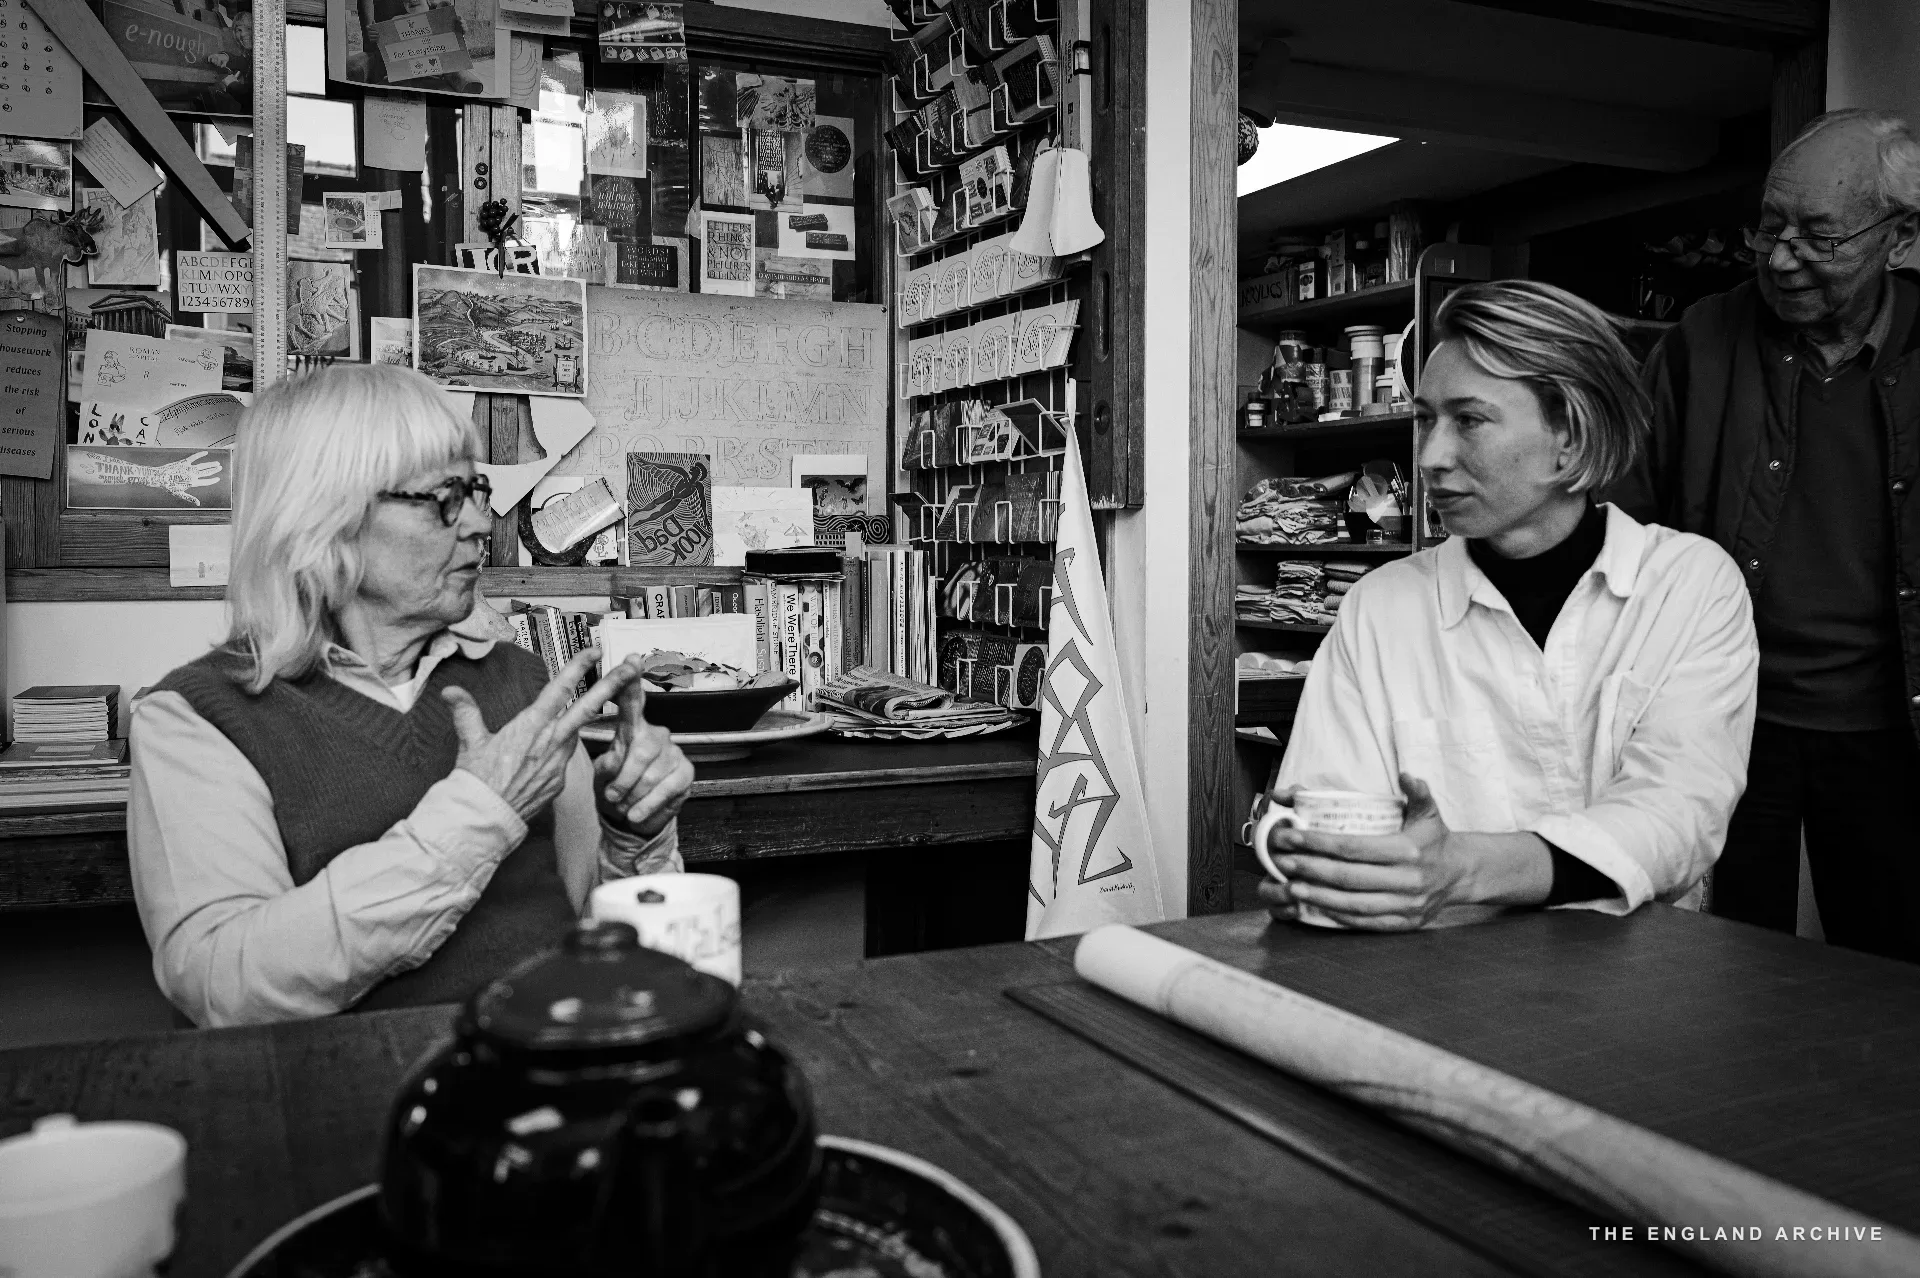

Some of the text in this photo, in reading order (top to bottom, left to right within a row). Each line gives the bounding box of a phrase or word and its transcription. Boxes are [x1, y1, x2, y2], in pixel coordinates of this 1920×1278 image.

[400, 26, 431, 38] THANKS
[718, 246, 752, 260] NOT
[182, 282, 253, 295] STUVWXY
[6, 323, 47, 338] Stopping
[0, 343, 51, 357] housework
[6, 365, 41, 377] reduces
[5, 384, 40, 397] the risk
[15, 406, 27, 415] of
[2, 426, 35, 437] serious
[0, 445, 36, 456] diseases
[95, 461, 134, 476] THANK
[754, 597, 765, 643] Flashlight
[786, 594, 798, 676] We Were There
